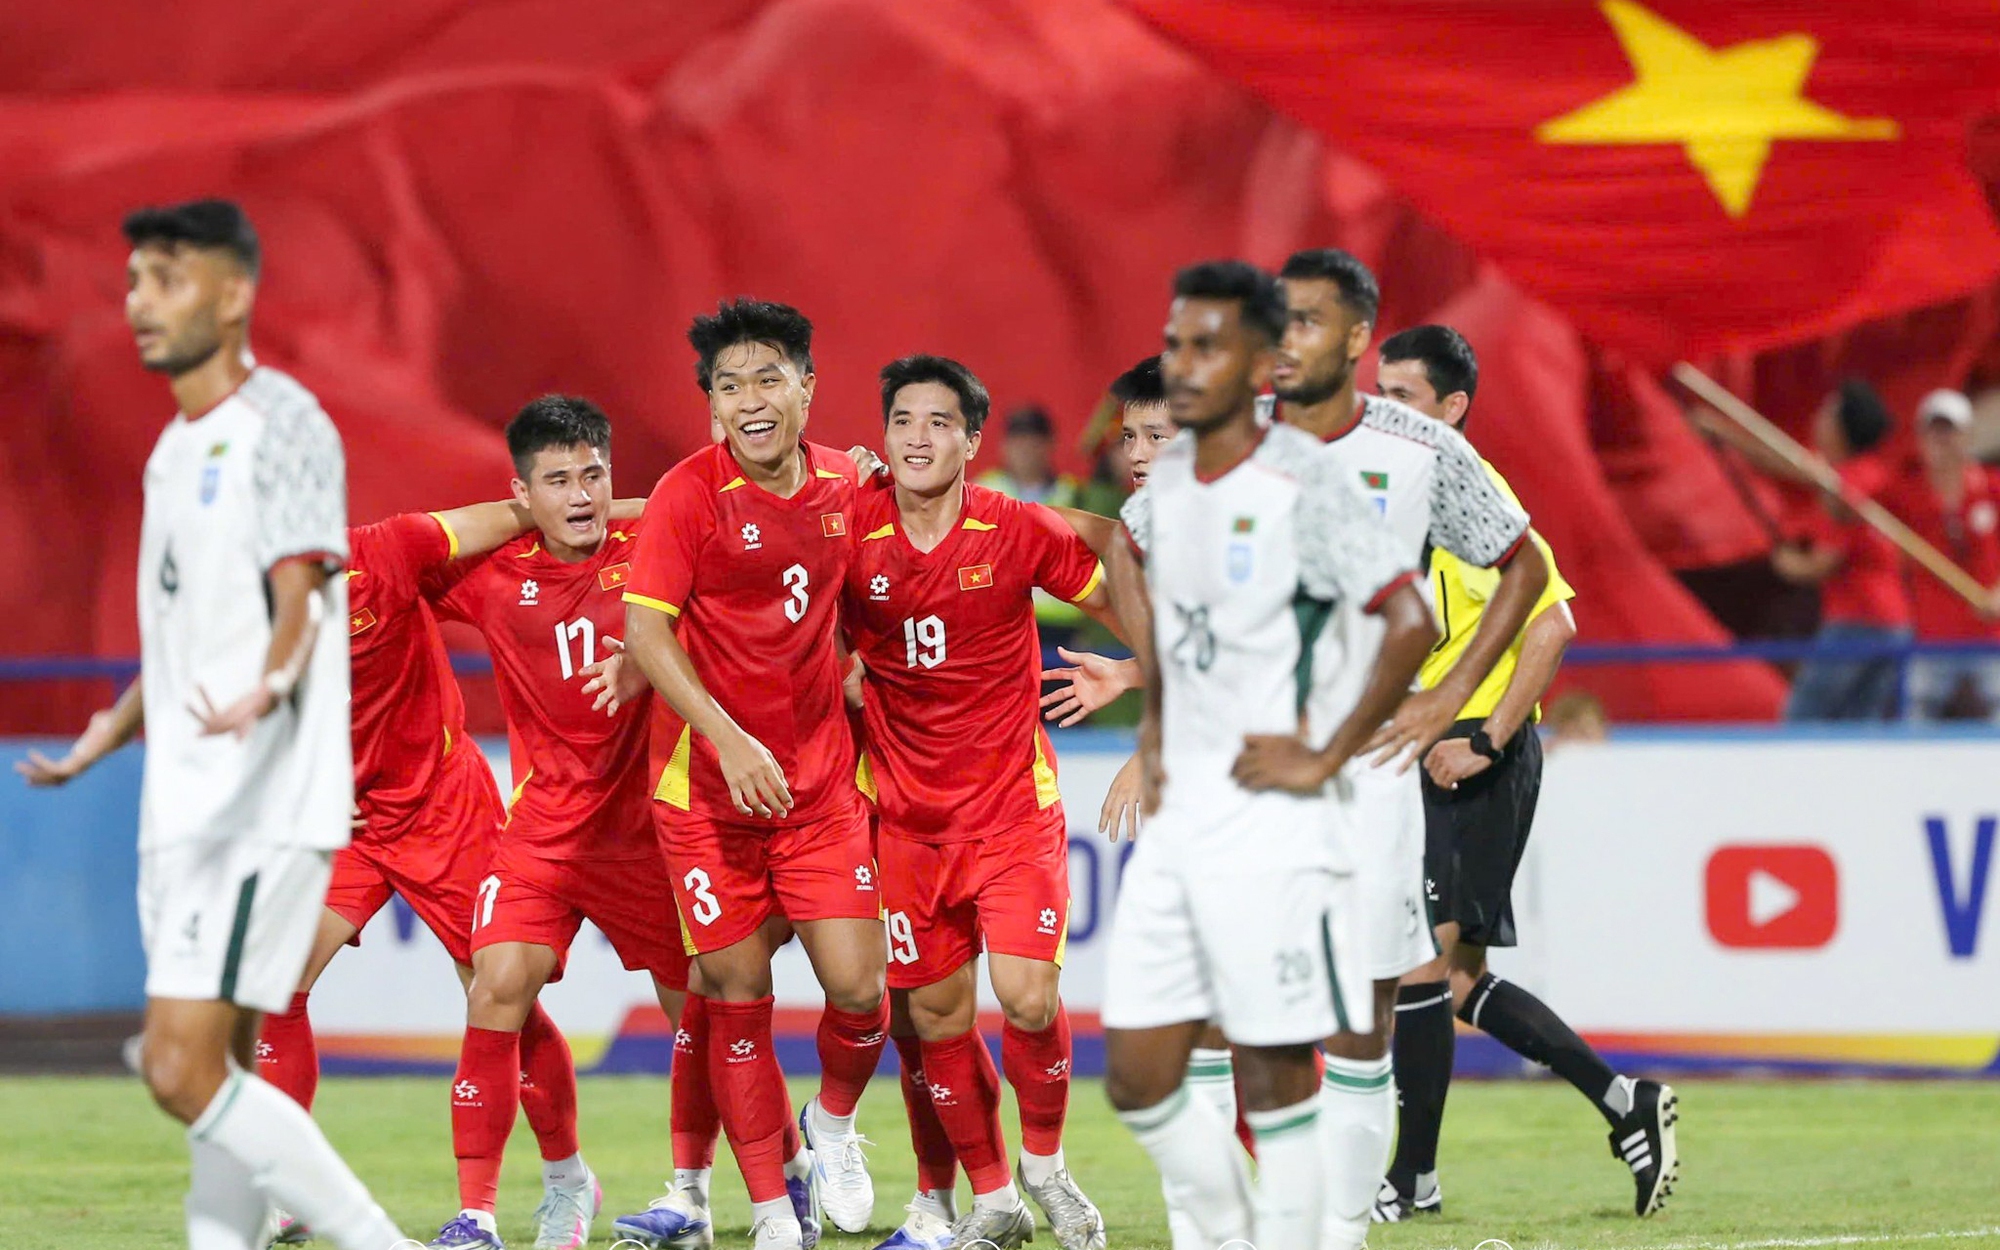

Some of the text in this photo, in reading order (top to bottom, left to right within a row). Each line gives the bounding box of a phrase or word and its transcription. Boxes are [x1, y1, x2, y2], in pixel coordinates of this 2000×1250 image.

[782, 563, 810, 624] 3
[554, 615, 595, 681] 17
[903, 614, 947, 670] 19
[683, 866, 723, 927] 3
[1923, 816, 1998, 958] V
[883, 907, 920, 966] 19
